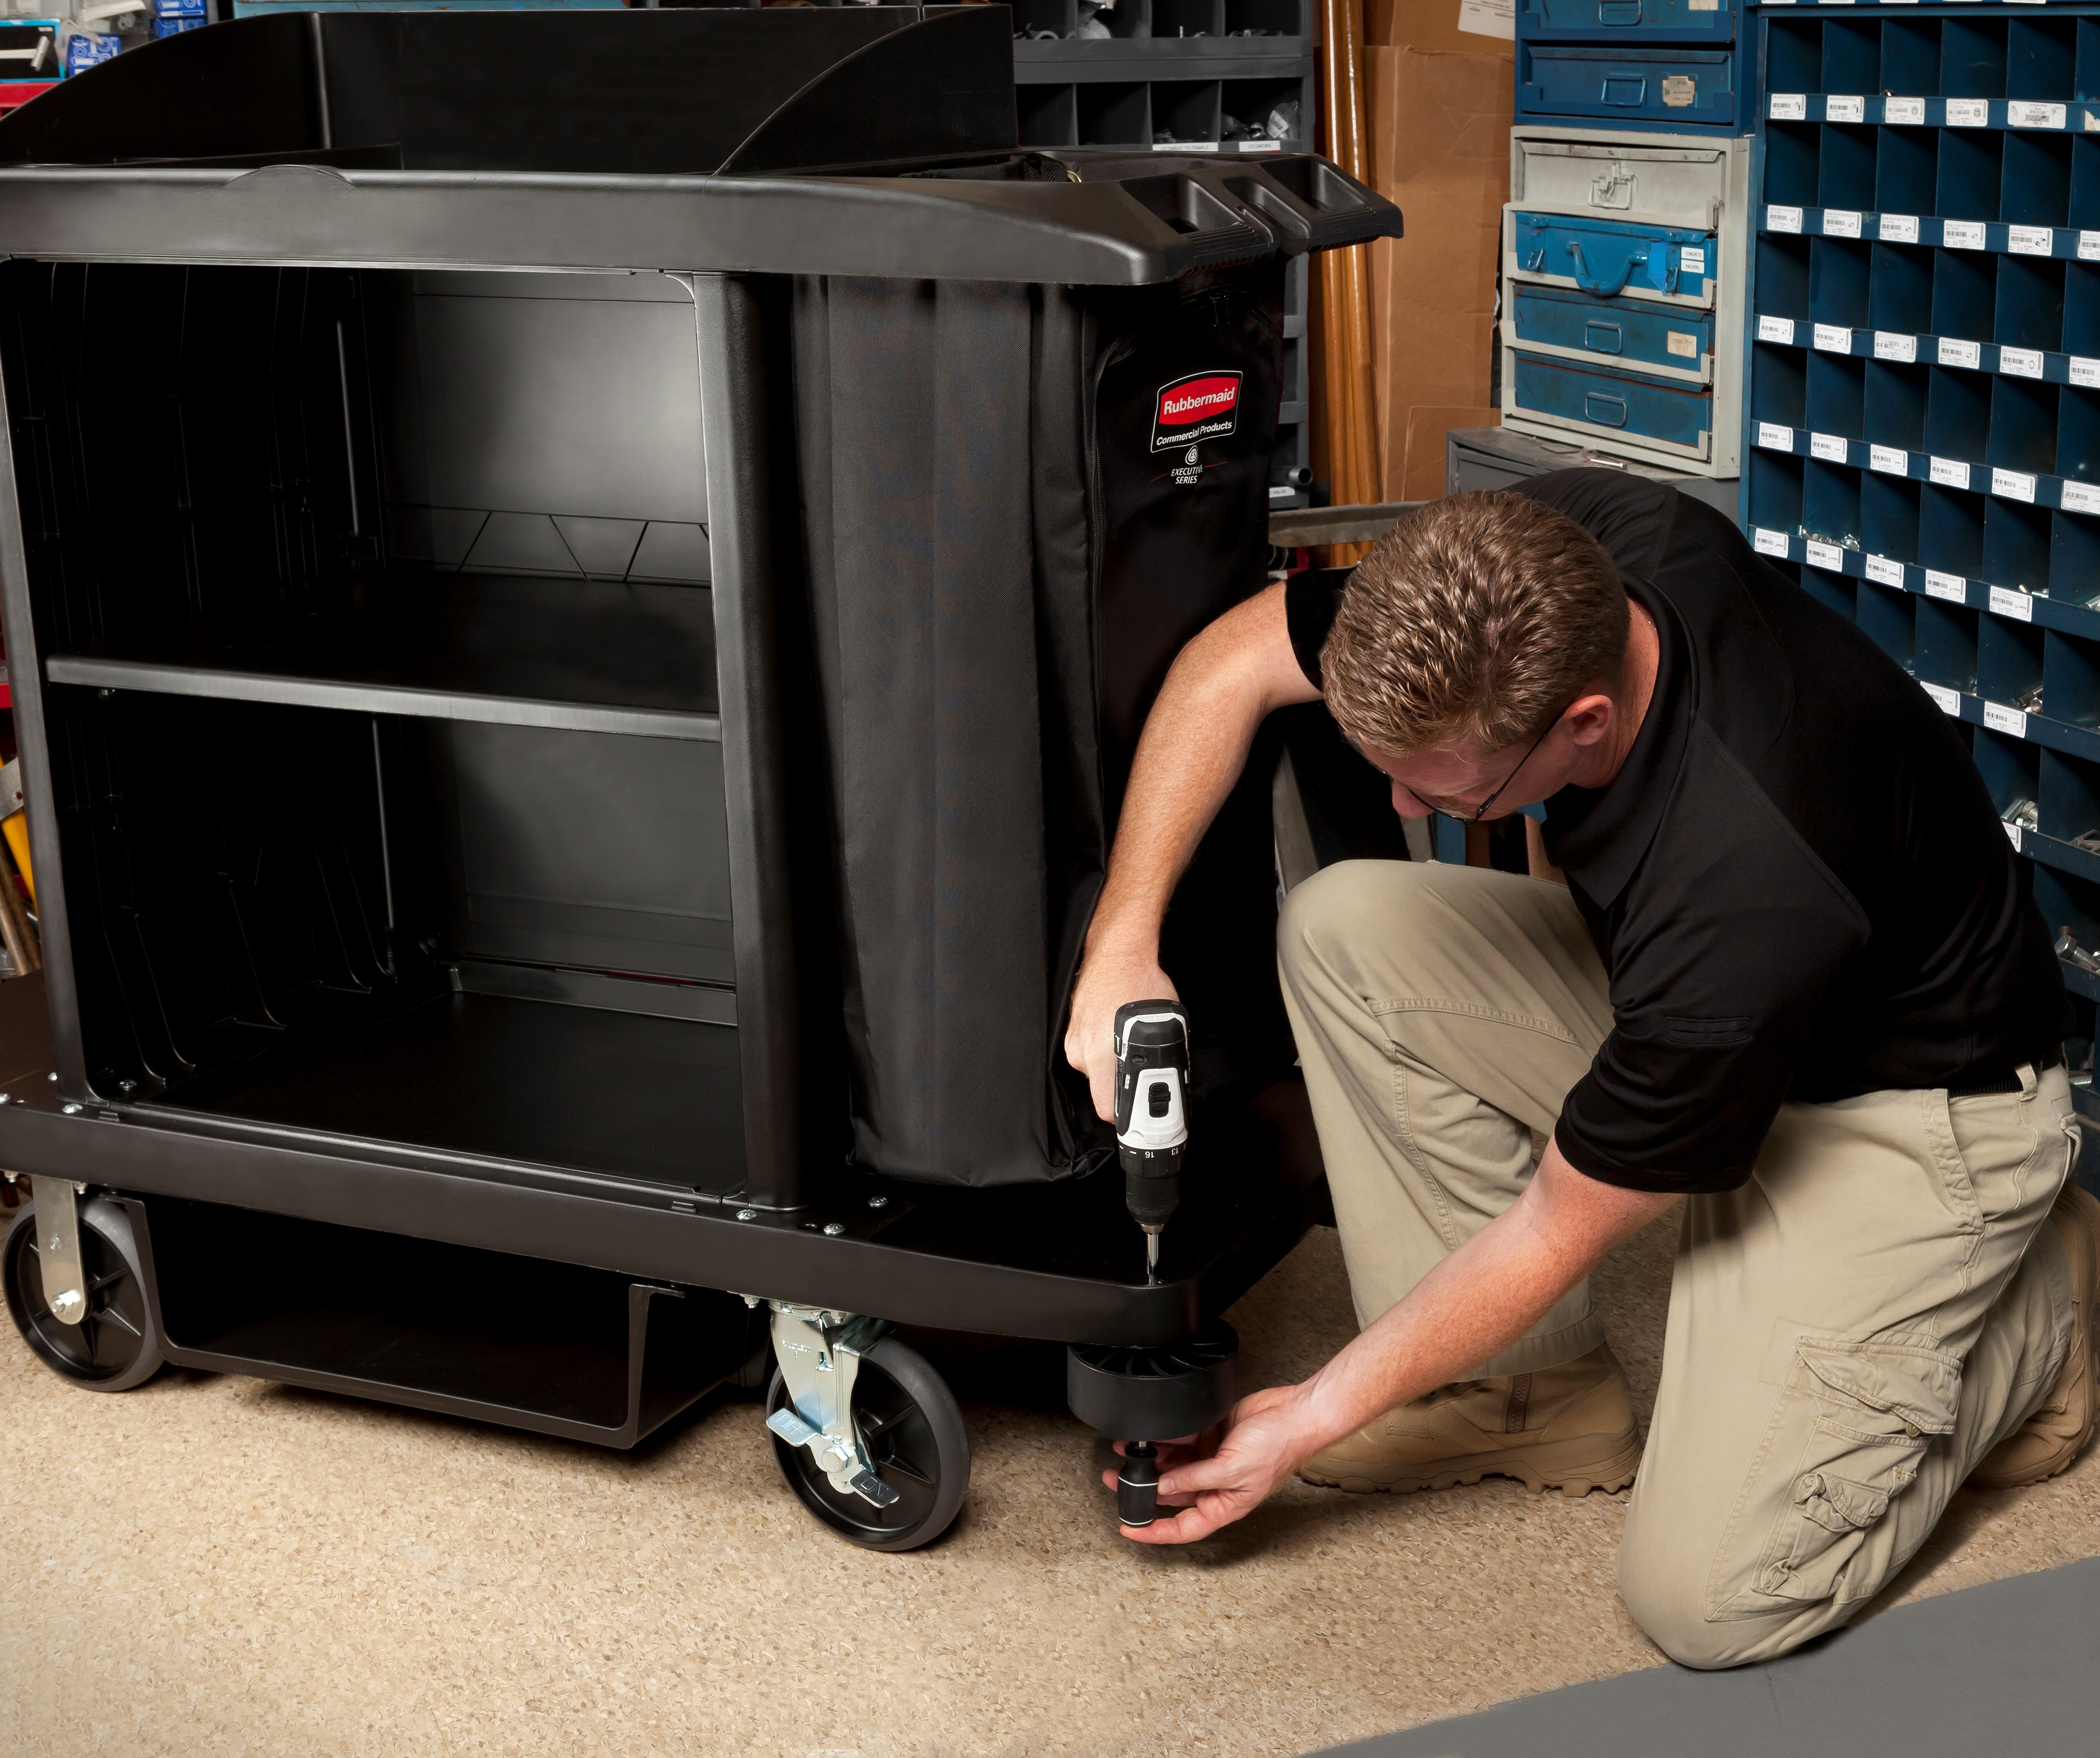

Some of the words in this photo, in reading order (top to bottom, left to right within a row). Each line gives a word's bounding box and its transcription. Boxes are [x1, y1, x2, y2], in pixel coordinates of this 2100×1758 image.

[1163, 387, 1236, 415] Rubbermaid
[1156, 427, 1199, 446] Commercial
[1200, 421, 1232, 435] Products
[1171, 464, 1203, 477] EXECUTIVE
[1175, 475, 1198, 484] SERIES
[1171, 1147, 1179, 1156] 13
[775, 1413, 808, 1434] OFF
[860, 1476, 889, 1498] ON
